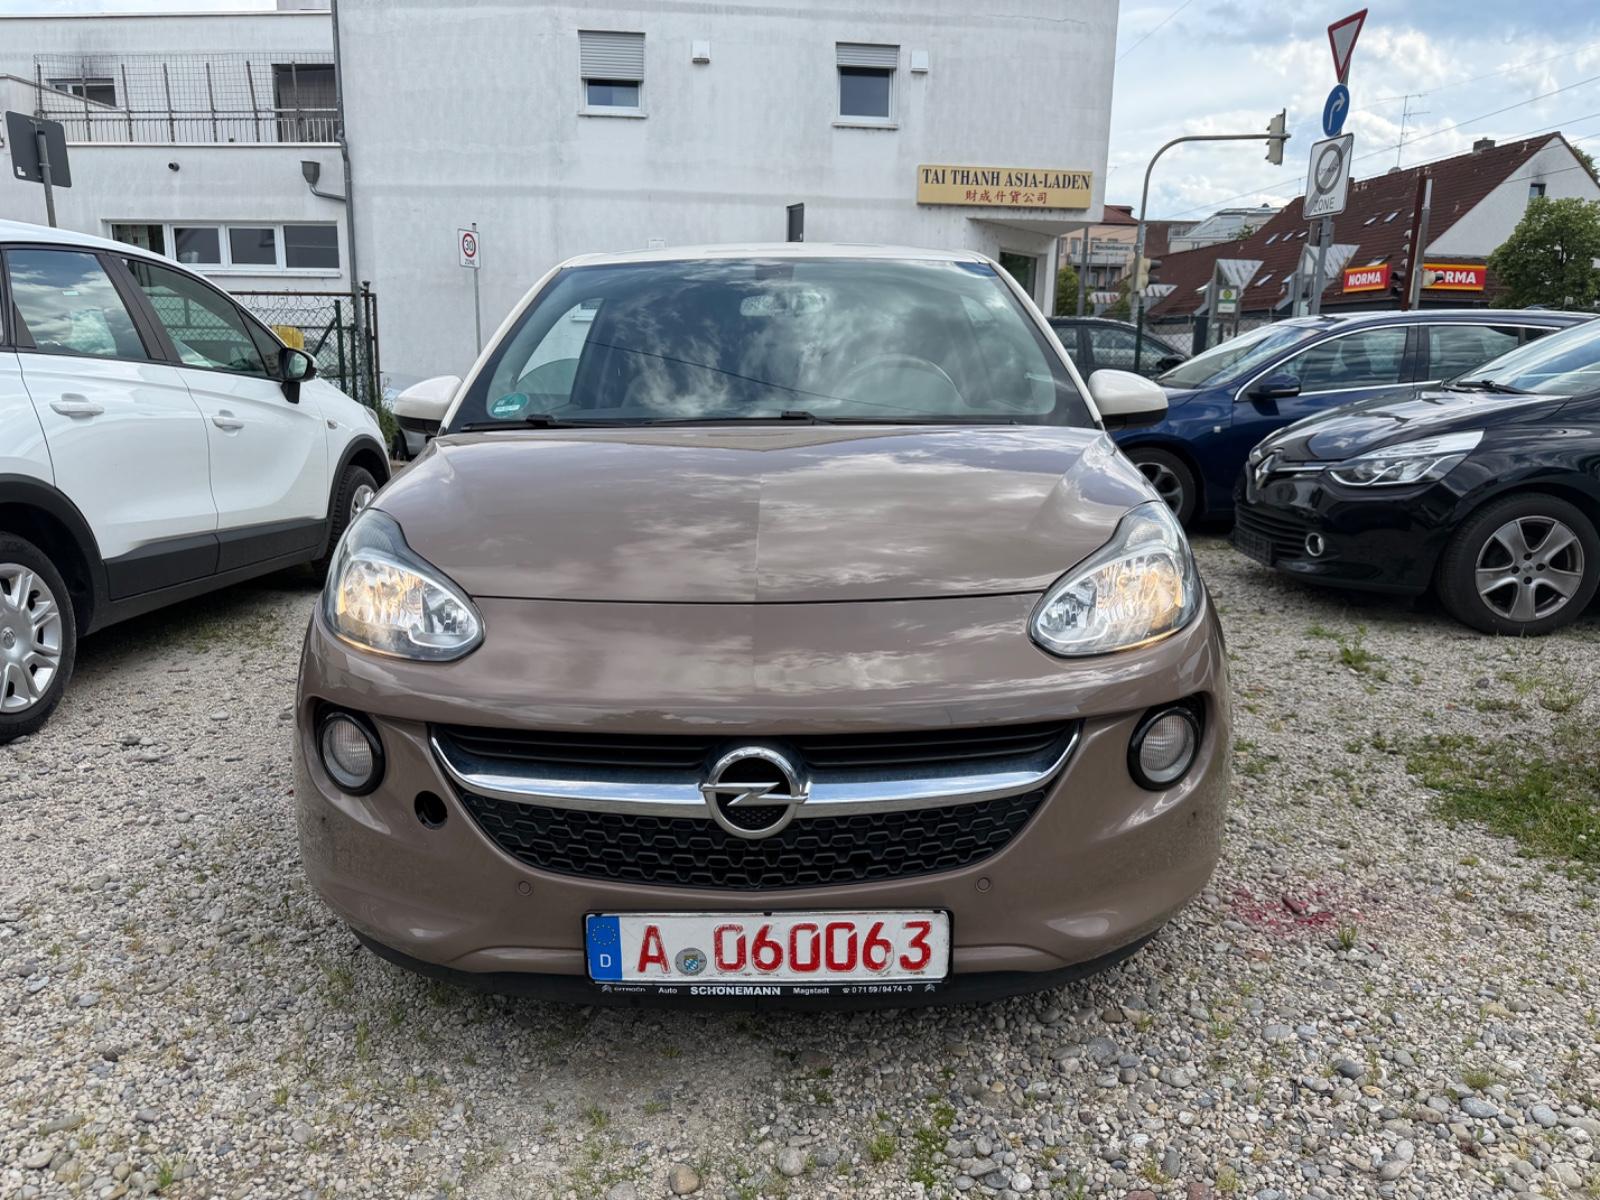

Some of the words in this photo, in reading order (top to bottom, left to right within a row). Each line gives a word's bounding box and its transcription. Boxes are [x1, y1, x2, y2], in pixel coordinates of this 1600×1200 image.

[923, 168, 946, 184] TAI
[951, 169, 1000, 186] THANH
[1004, 171, 1090, 190] ASIA-LADEN
[464, 239, 474, 252] 30
[1348, 271, 1381, 286] NORMA
[1431, 270, 1476, 284] ORMA
[637, 924, 670, 974] A
[713, 921, 933, 973] 060063
[600, 953, 612, 968] D
[658, 986, 678, 994] Auto
[690, 985, 781, 996] SCHÖNEMANN
[793, 987, 830, 996] Magstadt
